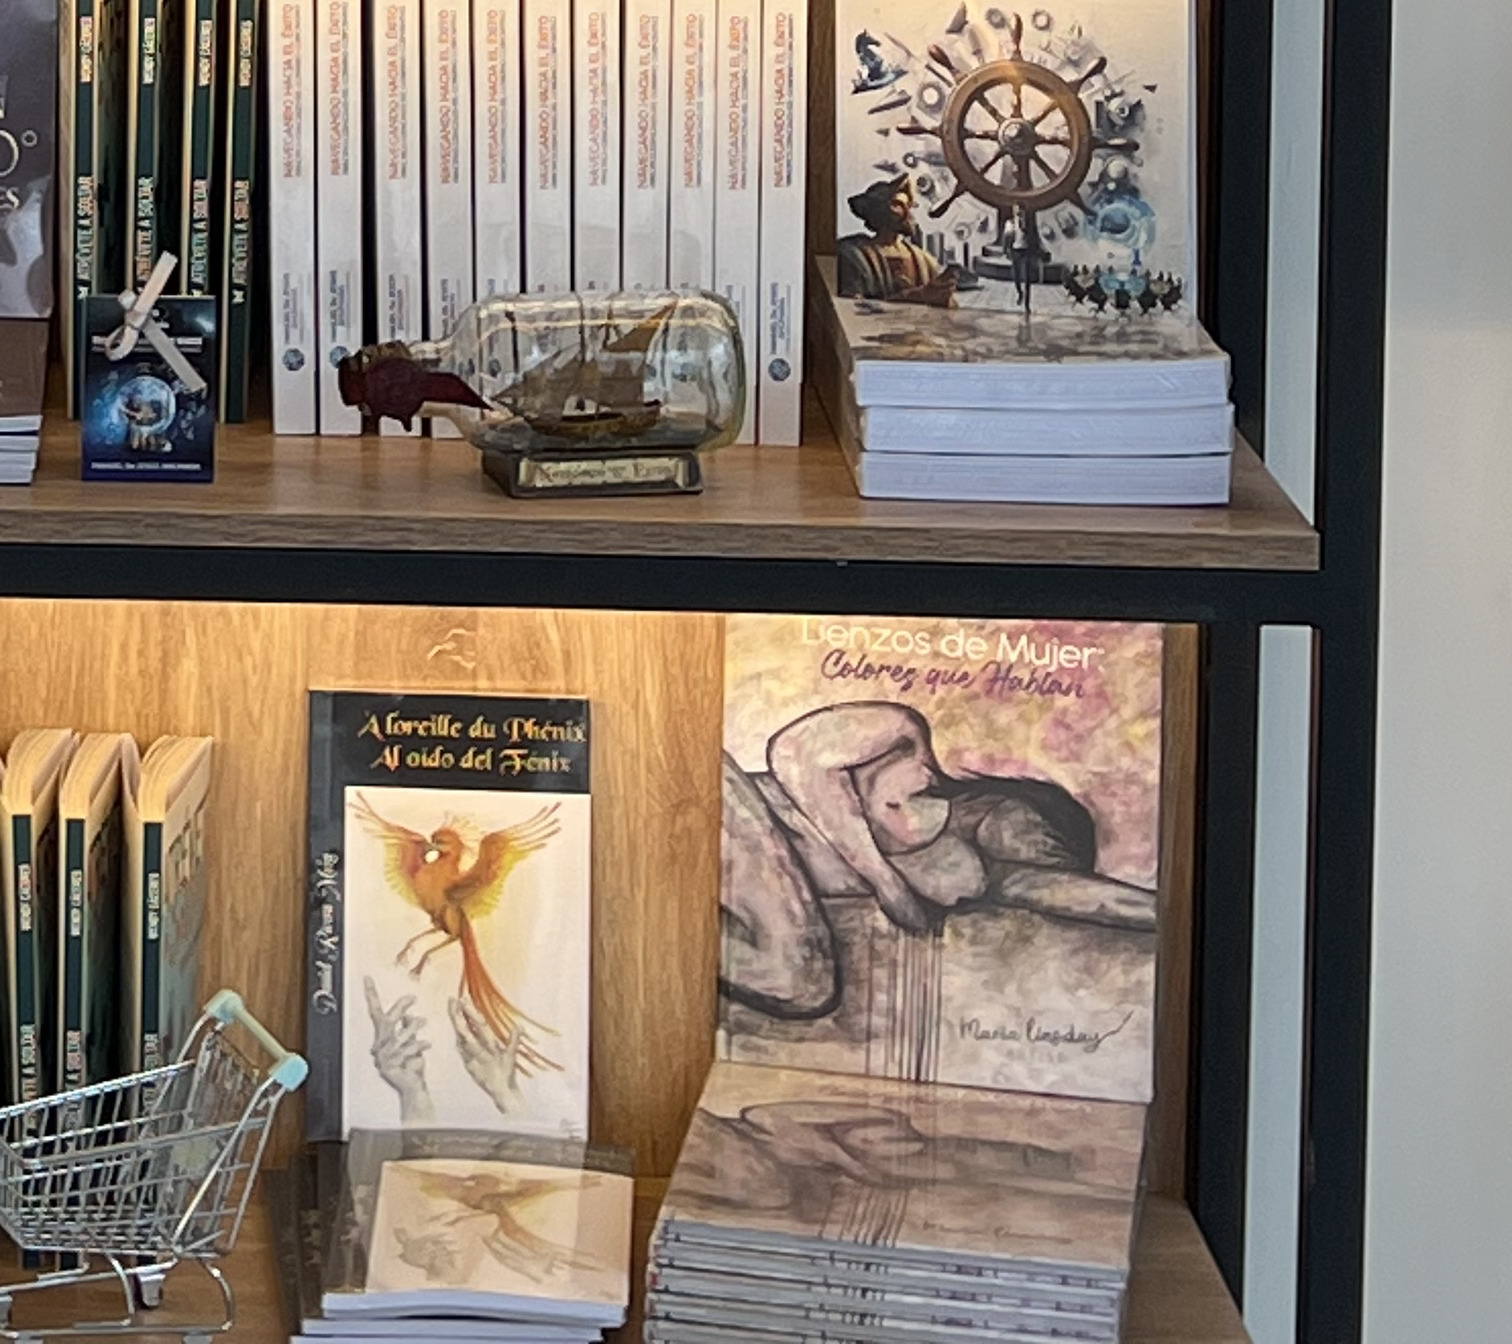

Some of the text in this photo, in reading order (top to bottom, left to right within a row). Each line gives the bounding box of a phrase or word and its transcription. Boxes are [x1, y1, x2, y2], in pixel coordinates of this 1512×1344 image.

[940, 628, 988, 660] de
[996, 633, 1106, 673] Mujer:
[821, 649, 1084, 699] Colores que Hablan
[370, 745, 403, 771] Al
[459, 746, 492, 771] del
